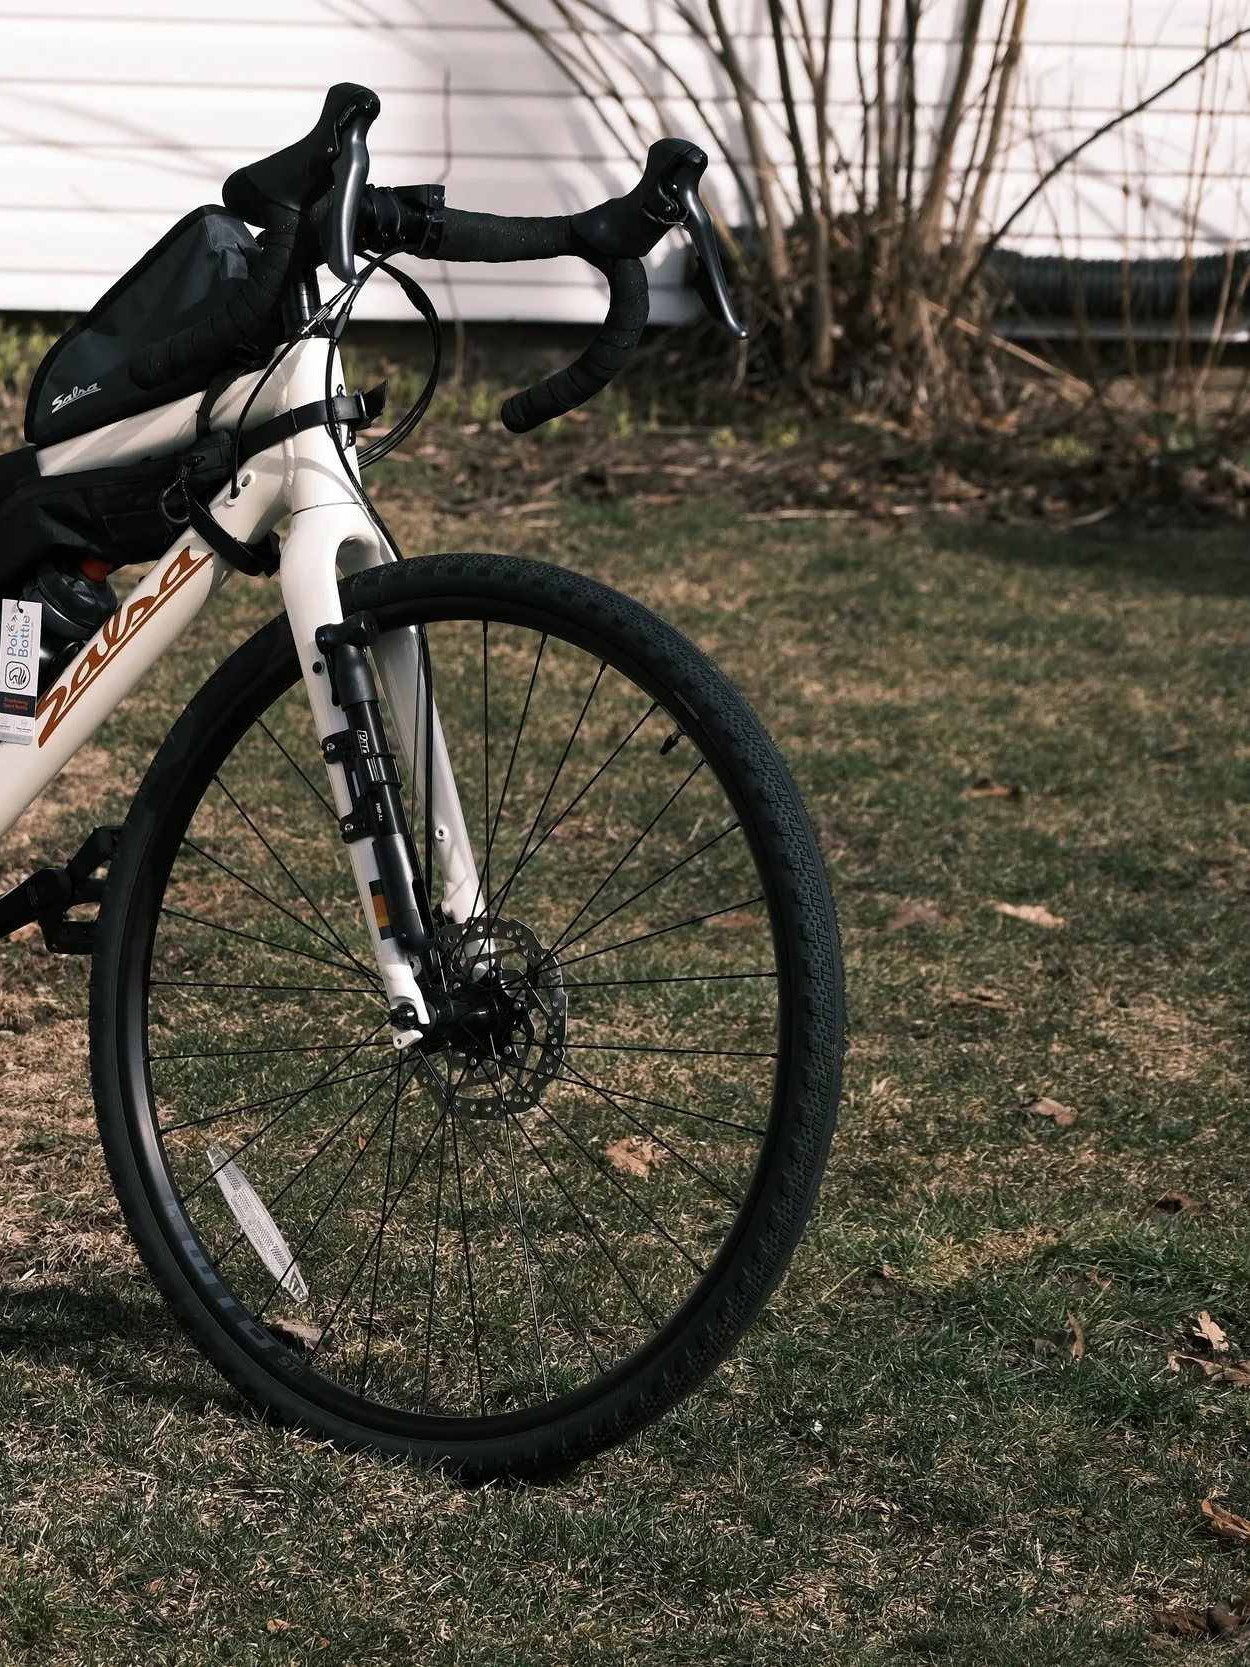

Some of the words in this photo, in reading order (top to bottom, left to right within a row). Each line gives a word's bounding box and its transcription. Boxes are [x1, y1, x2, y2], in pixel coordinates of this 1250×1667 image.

[52, 383, 101, 413] Salsa
[7, 633, 18, 656] Pol
[18, 616, 30, 658] Bottle
[35, 546, 213, 748] Salsa
